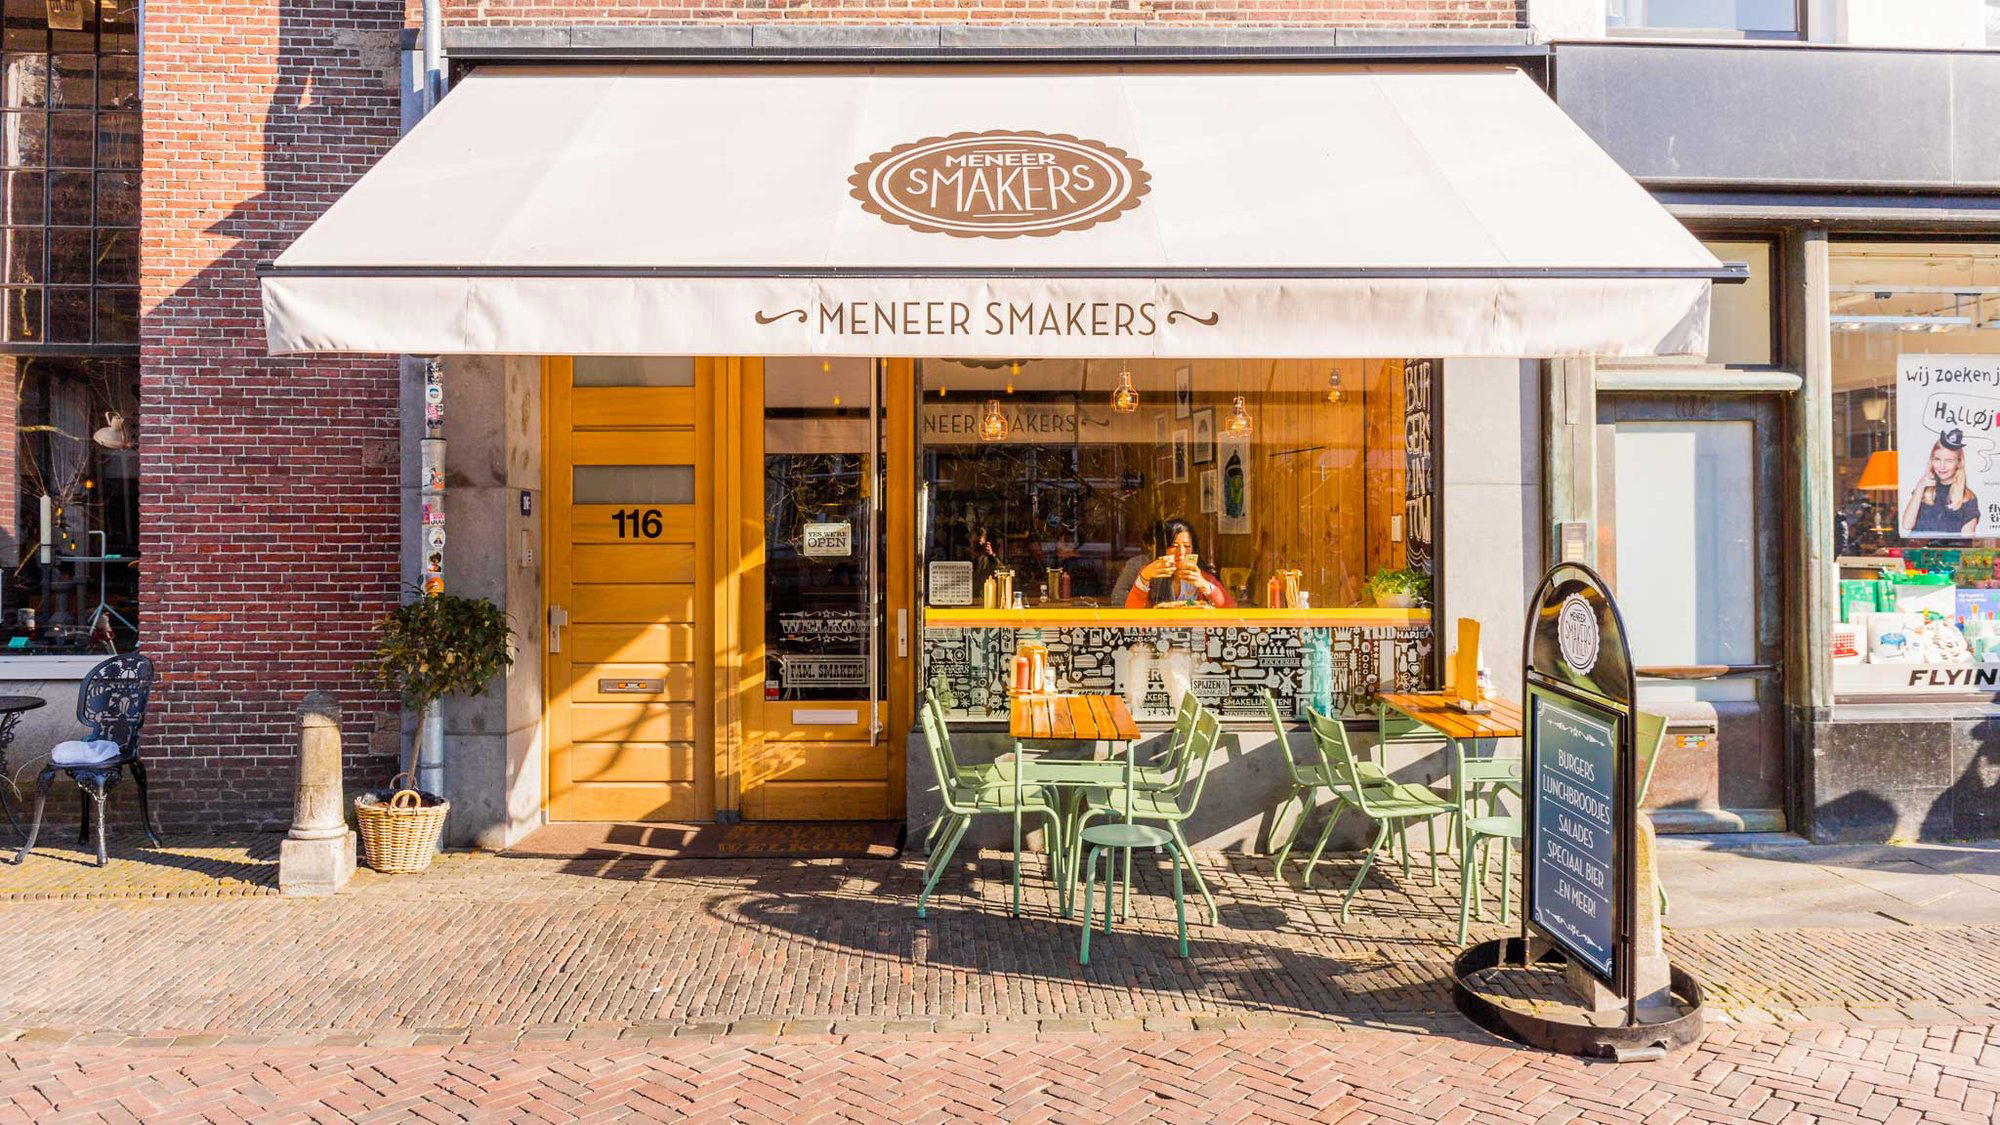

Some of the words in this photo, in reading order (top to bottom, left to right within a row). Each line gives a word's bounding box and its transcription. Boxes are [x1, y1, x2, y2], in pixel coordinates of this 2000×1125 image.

[945, 152, 1056, 167] MENEER
[905, 163, 1095, 212] SMAKERS
[819, 301, 971, 335] MENEER
[984, 301, 1157, 336] SMAKERS
[1906, 366, 1929, 387] wij
[1935, 367, 1991, 383] zoeken
[611, 509, 663, 538] 116
[808, 538, 846, 548] OPEN
[818, 664, 864, 678] SMAKERS
[1909, 669, 2000, 686] FLYIN
[1558, 749, 1595, 783] BURGERS
[1542, 773, 1611, 825] LUNCHBROODJES
[1558, 814, 1594, 849] SALADES
[1547, 840, 1583, 878] SPECIAAL
[1586, 861, 1604, 891] BIER
[1571, 887, 1596, 919] MEER!
